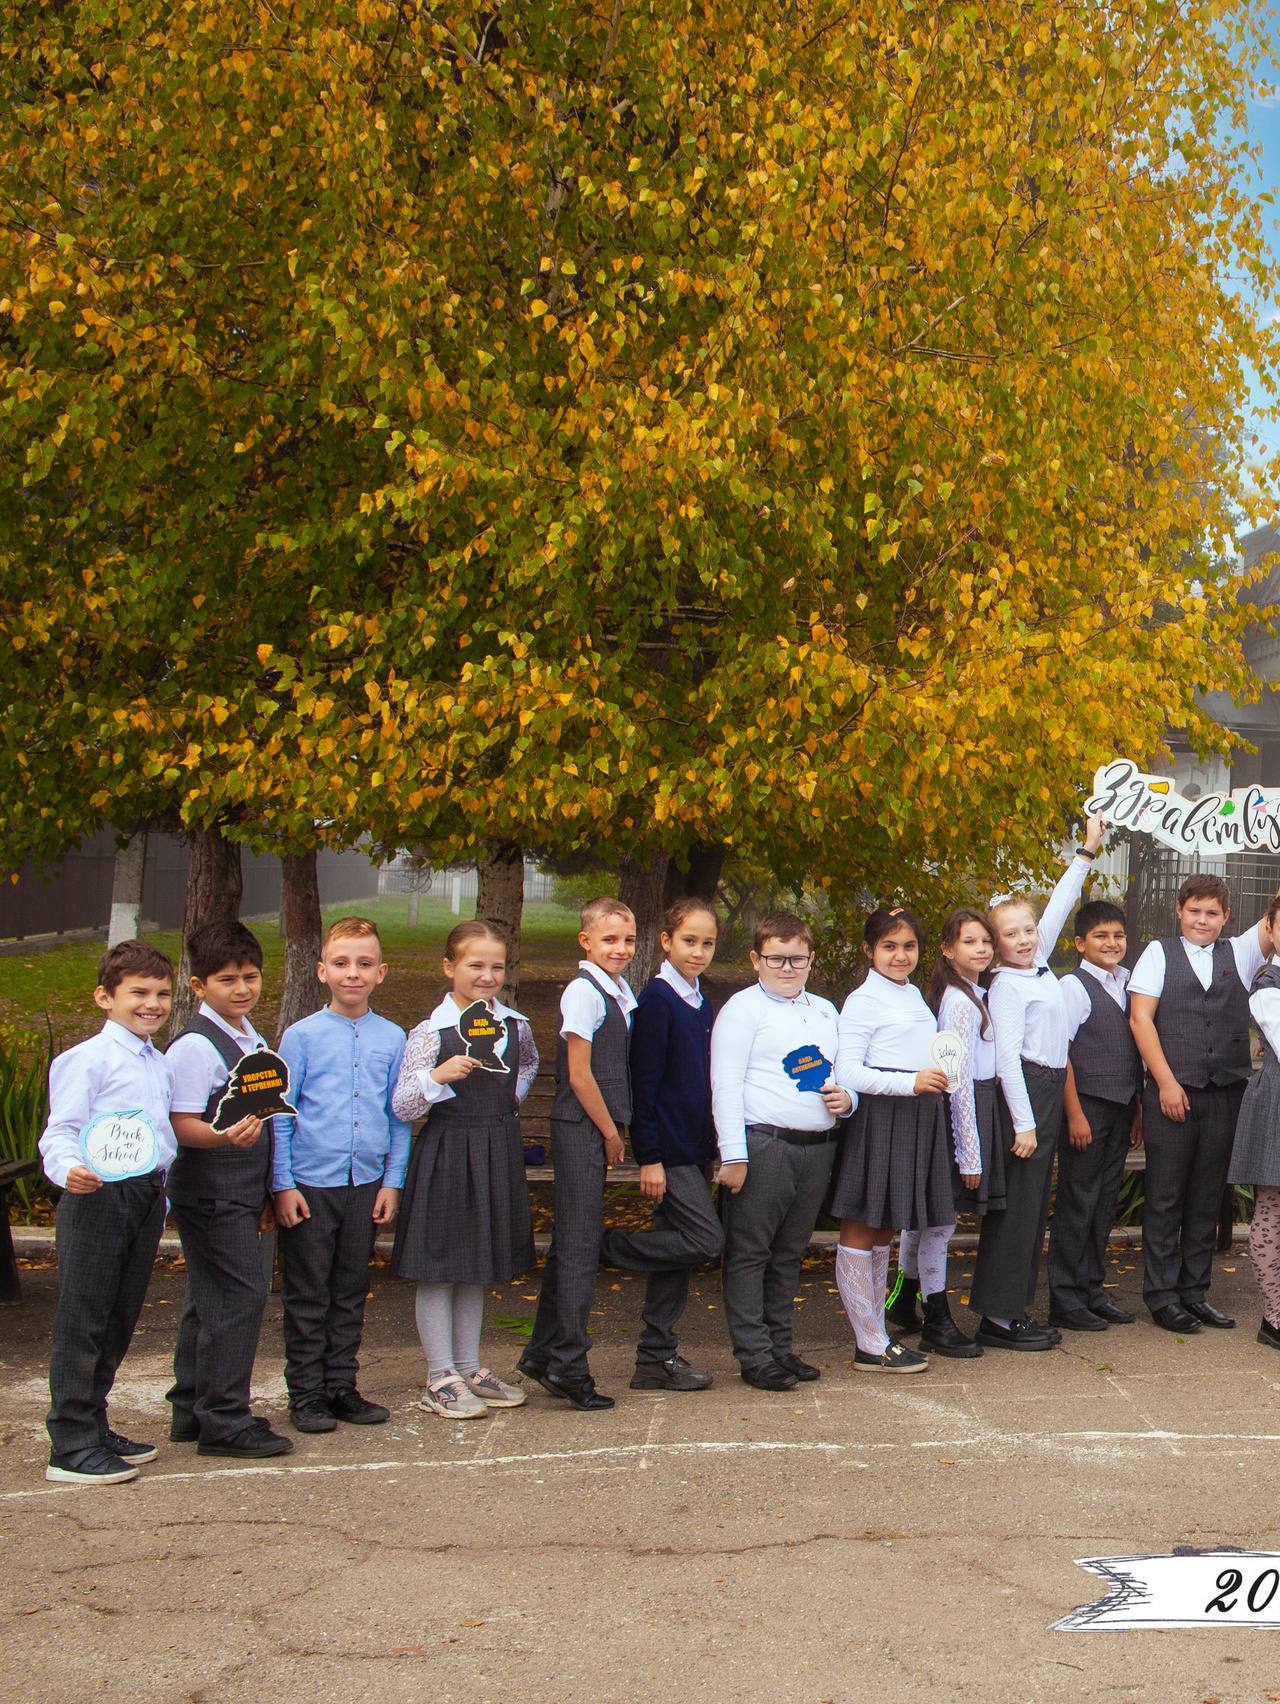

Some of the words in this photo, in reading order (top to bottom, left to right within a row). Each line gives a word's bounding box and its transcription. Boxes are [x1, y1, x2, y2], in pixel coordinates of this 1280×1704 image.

[473, 1018, 489, 1027] БУДЬ
[939, 1044, 958, 1059] idea
[242, 1069, 277, 1083] УПОРСТВА
[241, 1085, 248, 1094] И
[248, 1078, 283, 1092] ТЕРПЕНИЯ!
[106, 1123, 144, 1141] Back
[98, 1144, 142, 1162] School
